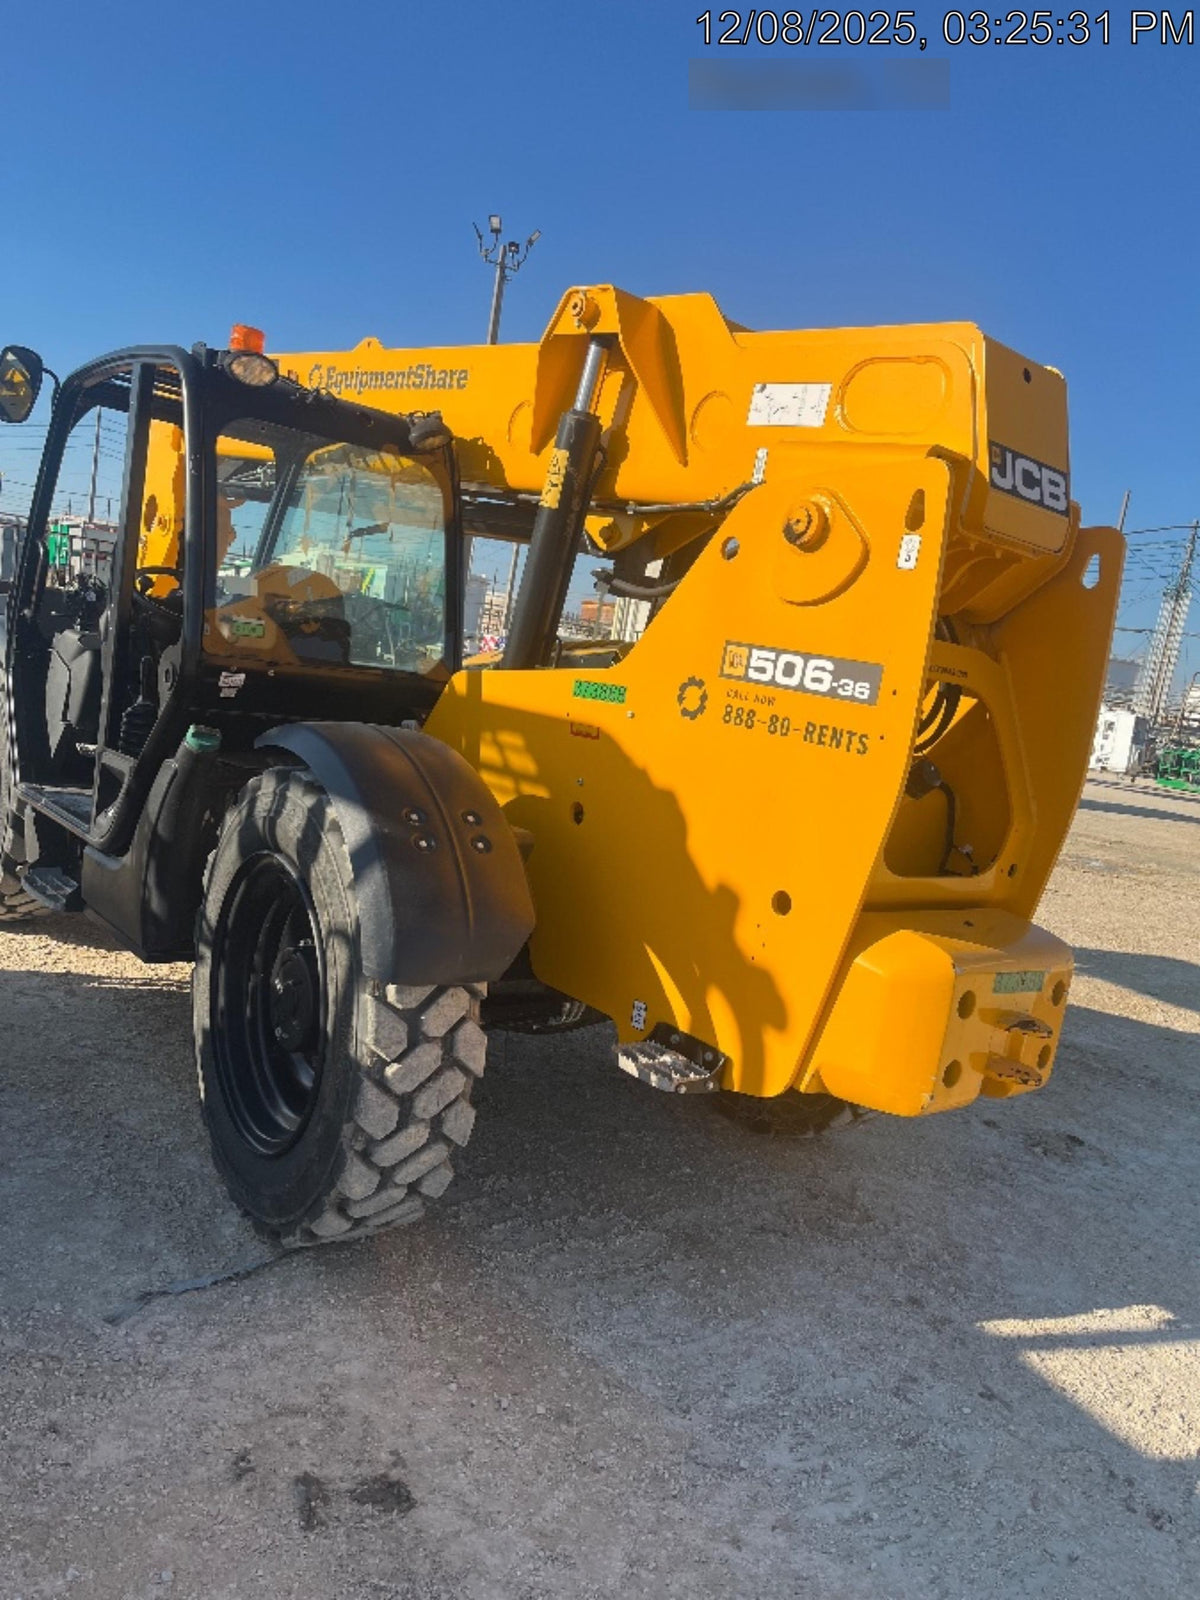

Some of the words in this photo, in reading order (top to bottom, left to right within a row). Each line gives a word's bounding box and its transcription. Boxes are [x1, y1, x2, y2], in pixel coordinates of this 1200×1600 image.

[326, 363, 469, 395] EquipmentShare
[991, 450, 1068, 512] JCB
[726, 688, 751, 702] CALL
[753, 693, 777, 707] NOW
[722, 703, 870, 756] 888-80-RENTS
